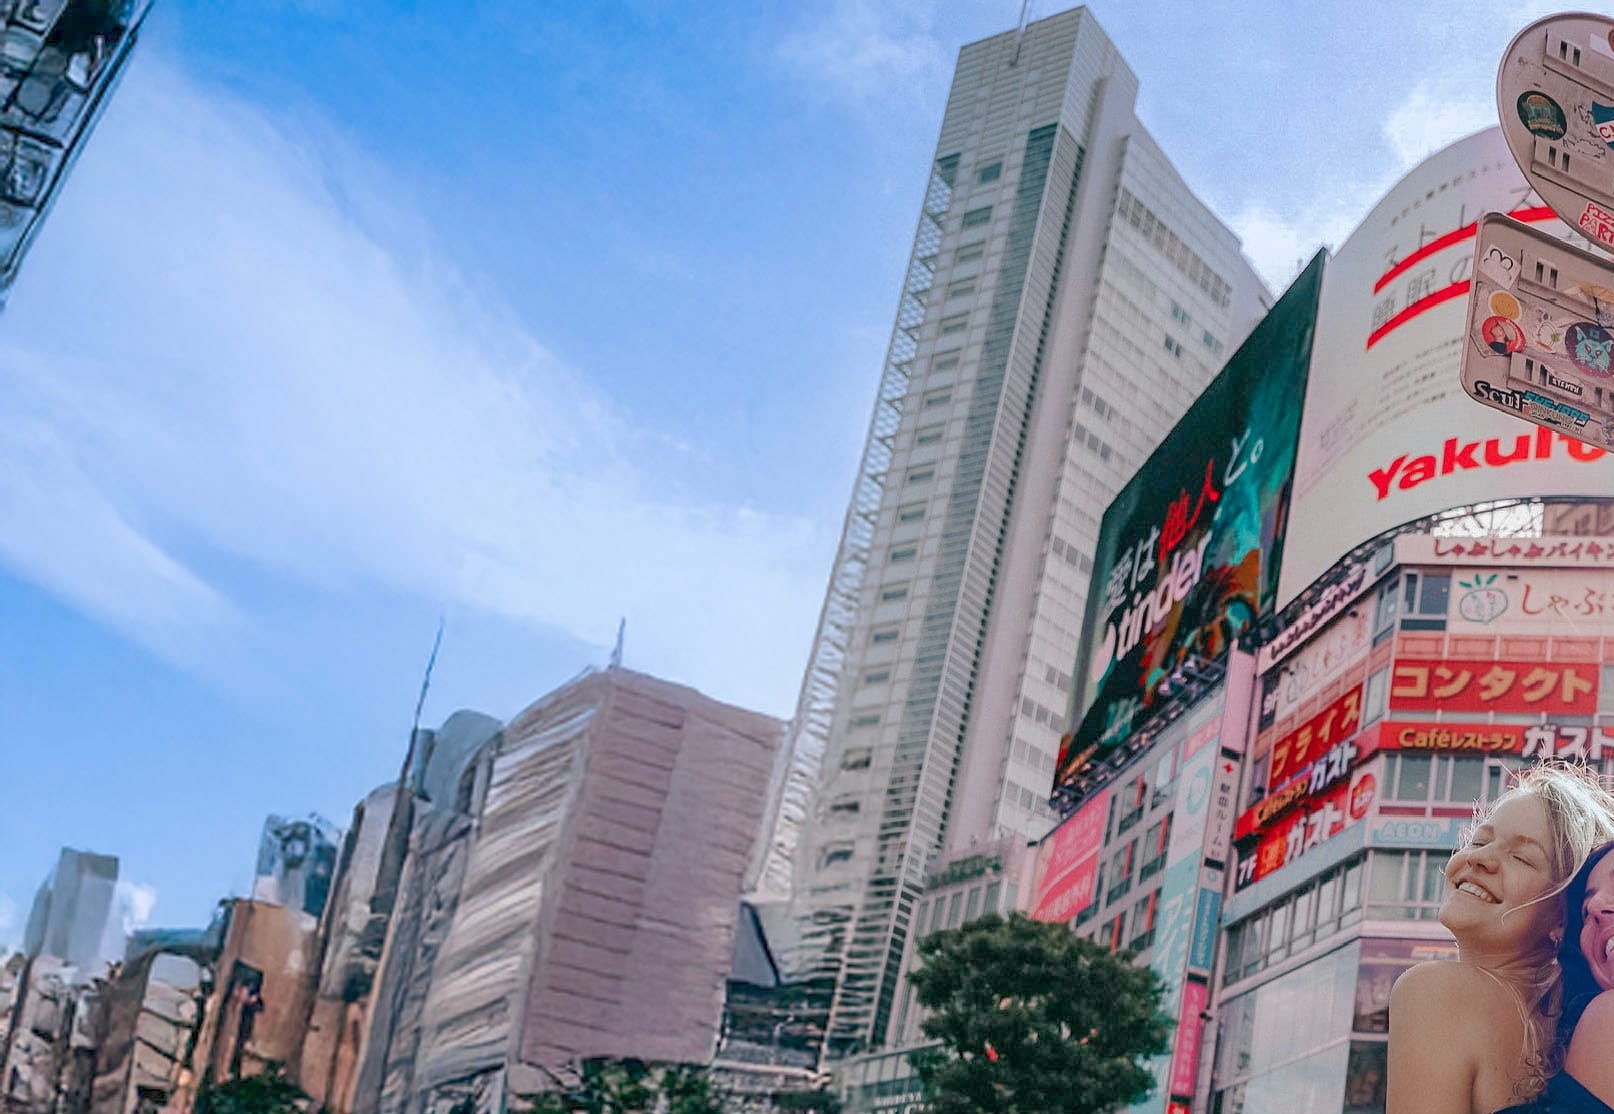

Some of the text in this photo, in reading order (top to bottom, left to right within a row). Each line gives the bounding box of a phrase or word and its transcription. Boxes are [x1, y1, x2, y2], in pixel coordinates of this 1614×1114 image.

[1368, 425, 1608, 502] Yakult
[1117, 528, 1213, 661] tinder
[1392, 665, 1593, 703] コンタクト
[1284, 801, 1343, 865] ガスト
